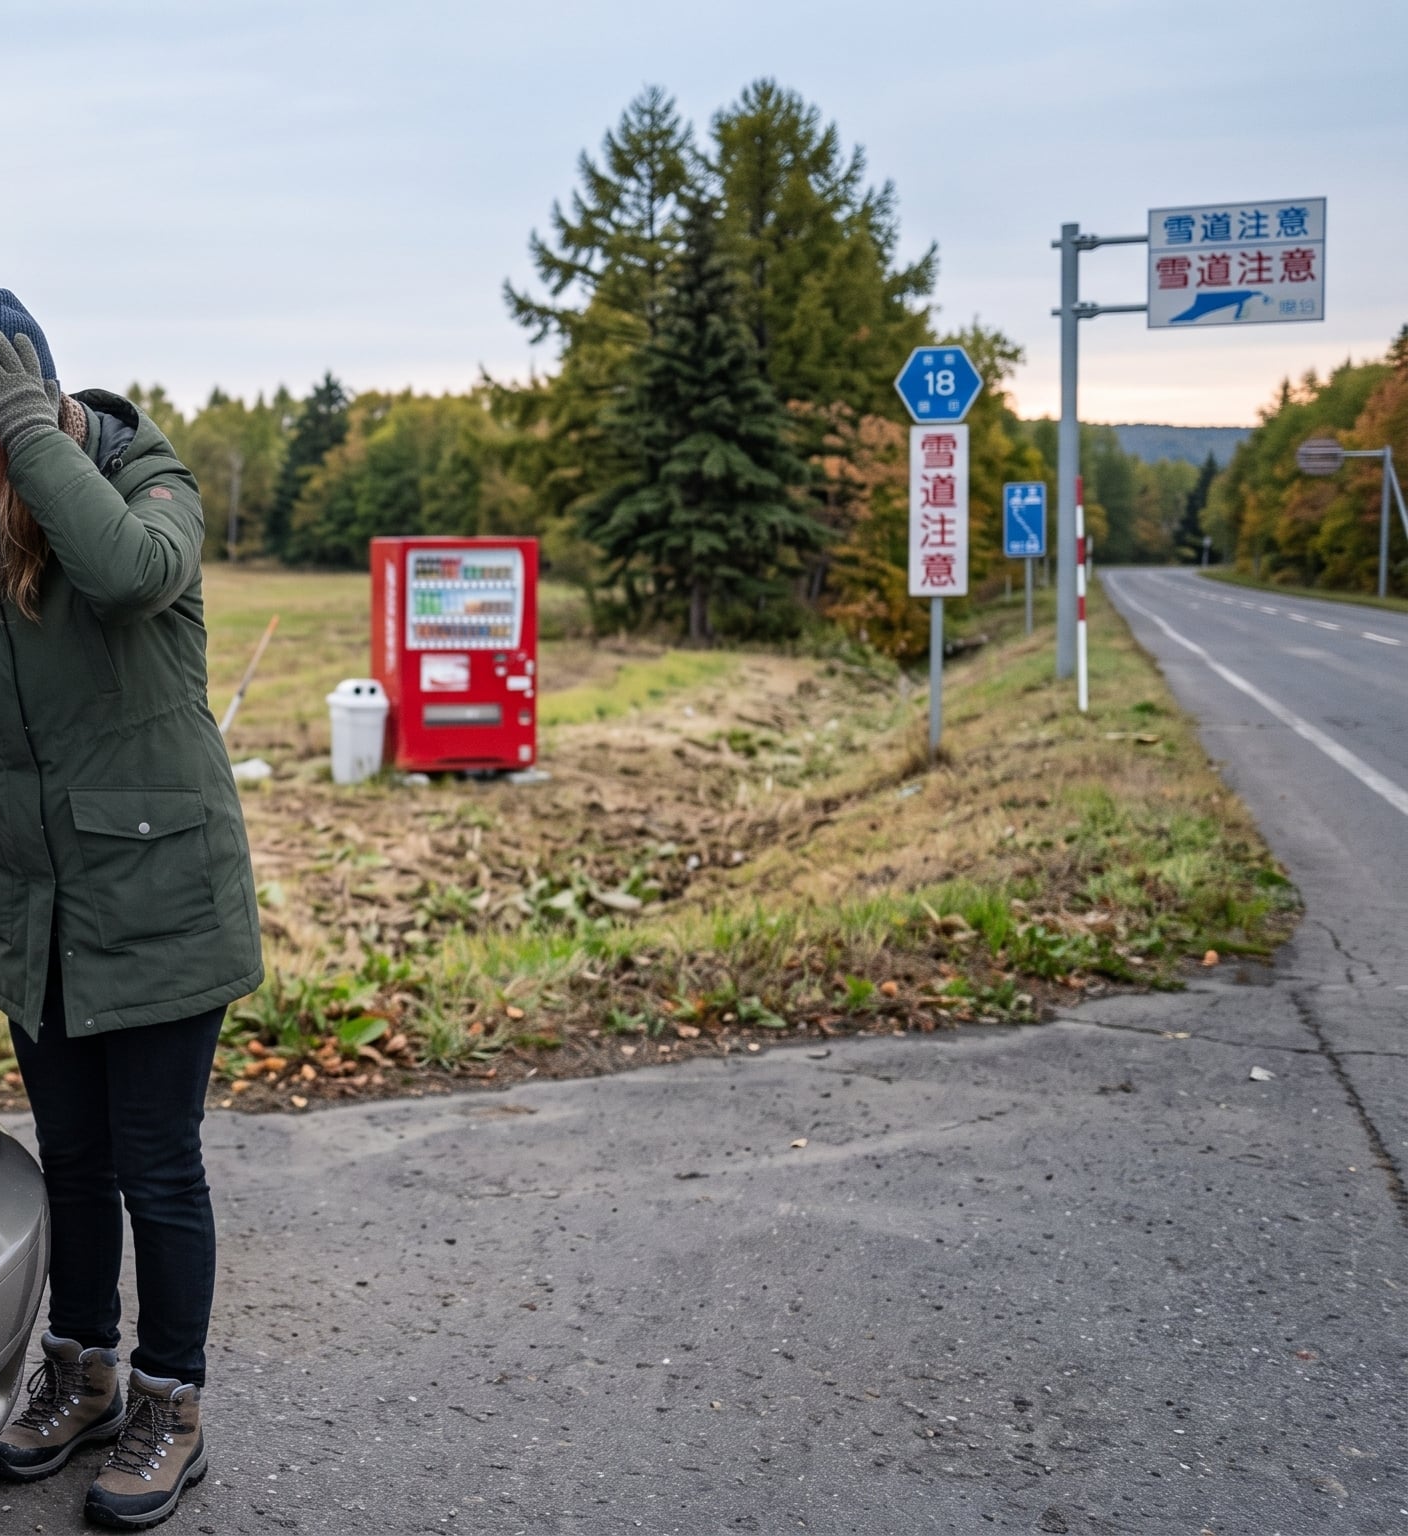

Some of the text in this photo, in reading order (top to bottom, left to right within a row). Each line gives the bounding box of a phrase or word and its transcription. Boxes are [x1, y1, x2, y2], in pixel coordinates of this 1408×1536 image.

[1163, 206, 1310, 245] 雪道注意
[1156, 247, 1317, 290] 雪道注意
[924, 369, 956, 397] 18
[921, 433, 957, 588] 雪道注意
